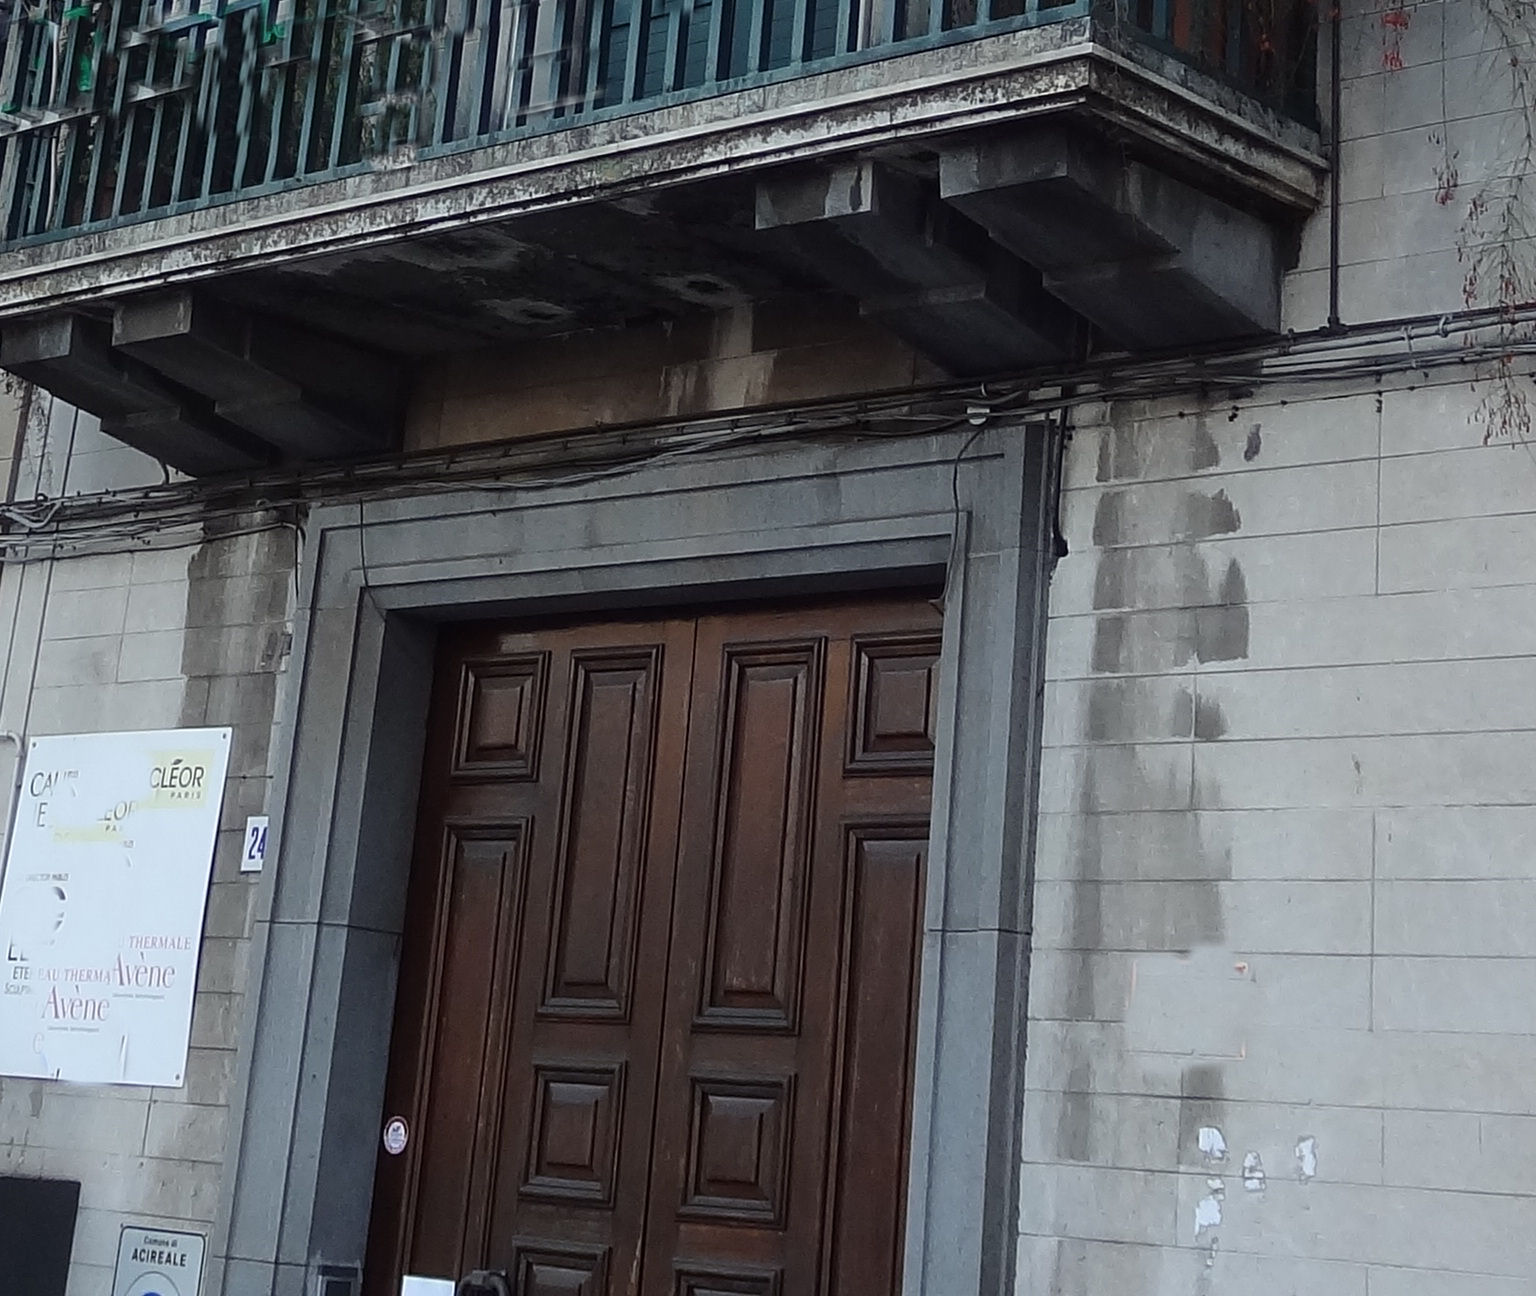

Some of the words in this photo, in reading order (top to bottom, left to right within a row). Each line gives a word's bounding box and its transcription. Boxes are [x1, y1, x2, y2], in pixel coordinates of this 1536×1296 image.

[150, 759, 205, 789] CLÉOR
[170, 790, 202, 800] PARIS
[129, 935, 192, 950] THERMALE
[113, 951, 175, 989] Avène
[41, 985, 110, 1021] Avène
[144, 1235, 170, 1247] Comune
[131, 1247, 187, 1267] ACIREALE
